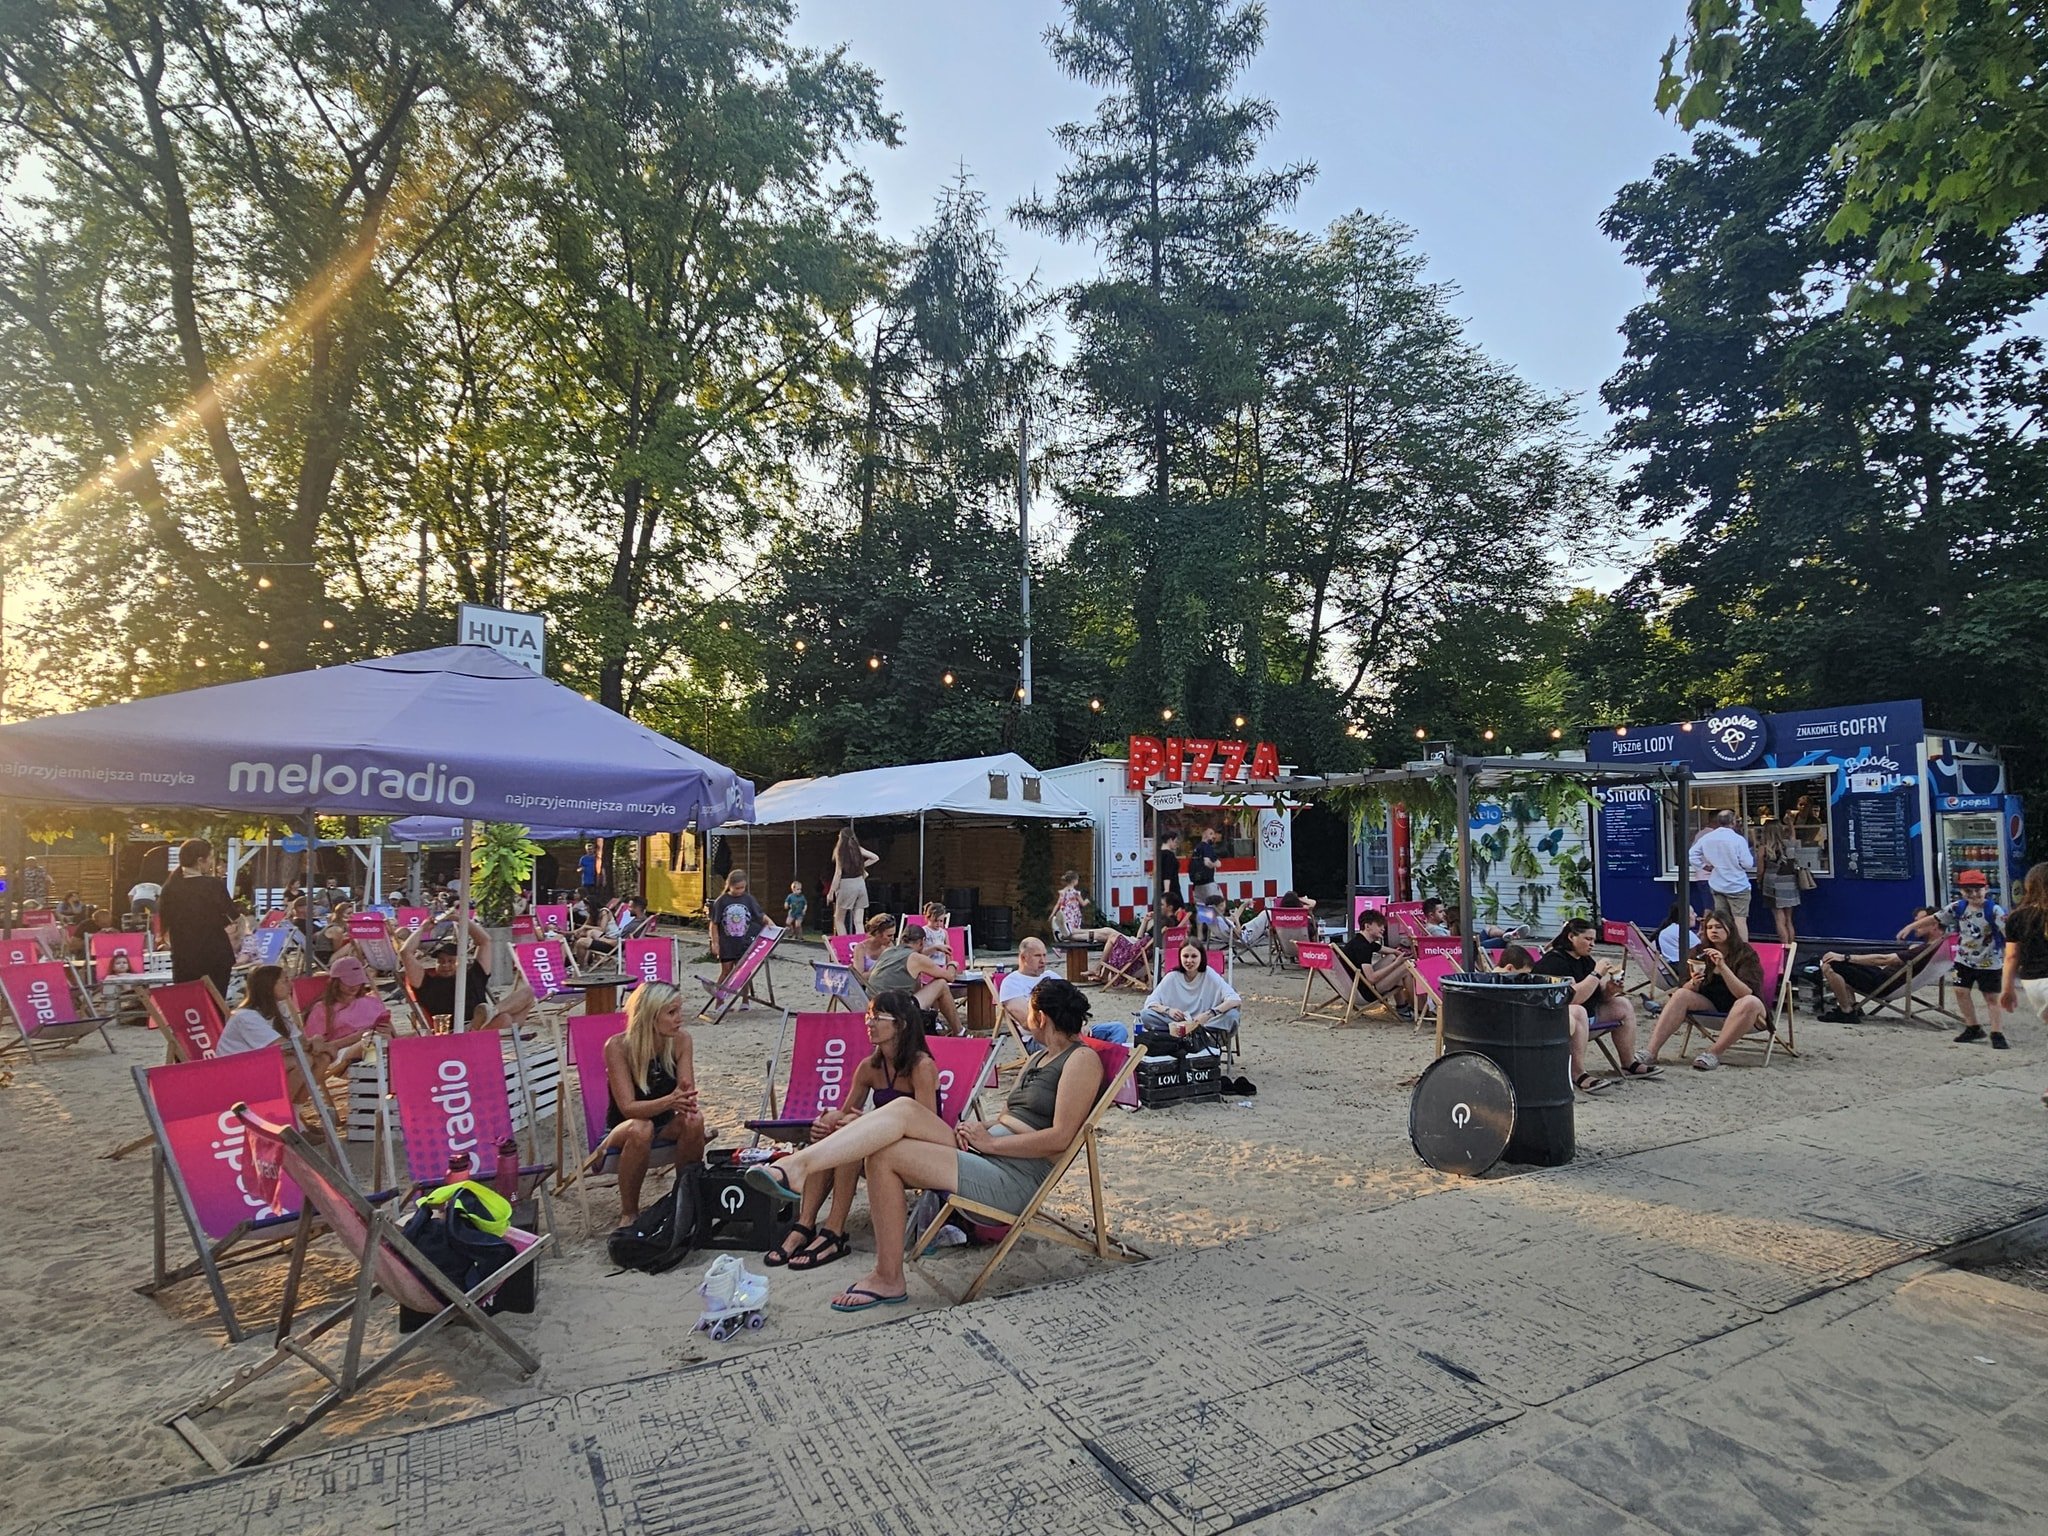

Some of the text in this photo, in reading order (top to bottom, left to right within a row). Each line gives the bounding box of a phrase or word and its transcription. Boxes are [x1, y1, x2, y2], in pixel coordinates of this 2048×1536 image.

[469, 621, 537, 650] HUTA
[1708, 714, 1757, 735] Boska
[1796, 715, 1887, 737] ZNAKOMITE GOFRY
[1612, 735, 1674, 753] Pyszne LODY
[1128, 735, 1280, 790] PIZZA
[1844, 755, 1899, 774] Boska
[139, 771, 195, 786] muzyka
[229, 753, 475, 806] meloradio
[505, 793, 677, 815] najprzyjemniejsza muzyka
[1960, 798, 1991, 808] pepsi
